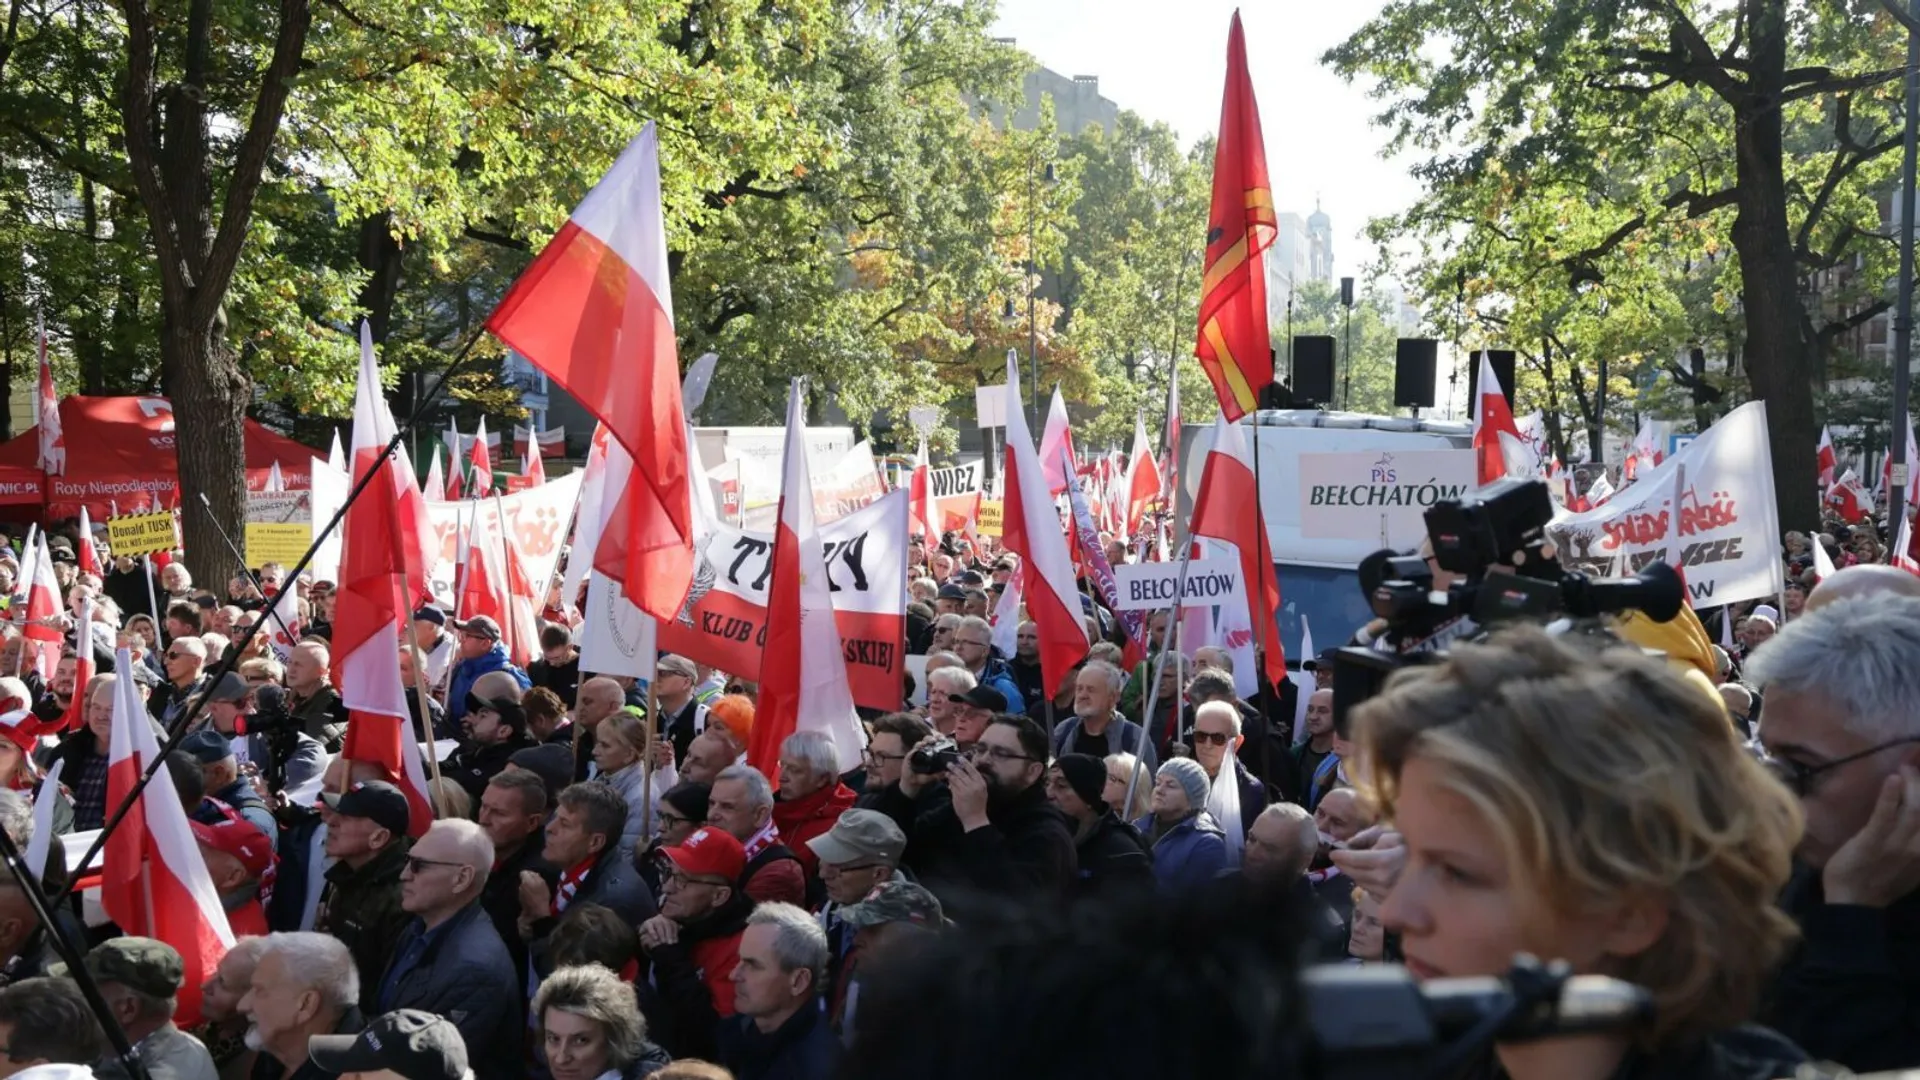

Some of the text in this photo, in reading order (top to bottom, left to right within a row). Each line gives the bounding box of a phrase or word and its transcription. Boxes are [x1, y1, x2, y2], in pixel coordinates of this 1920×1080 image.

[55, 480, 86, 498] Roty
[1310, 477, 1467, 506] BEŁCHATÓW
[112, 519, 172, 538] Donald TUSK
[1130, 569, 1235, 601] BEŁCHATÓW
[703, 611, 754, 643] KLUB
[842, 638, 894, 675] SKIEJ
